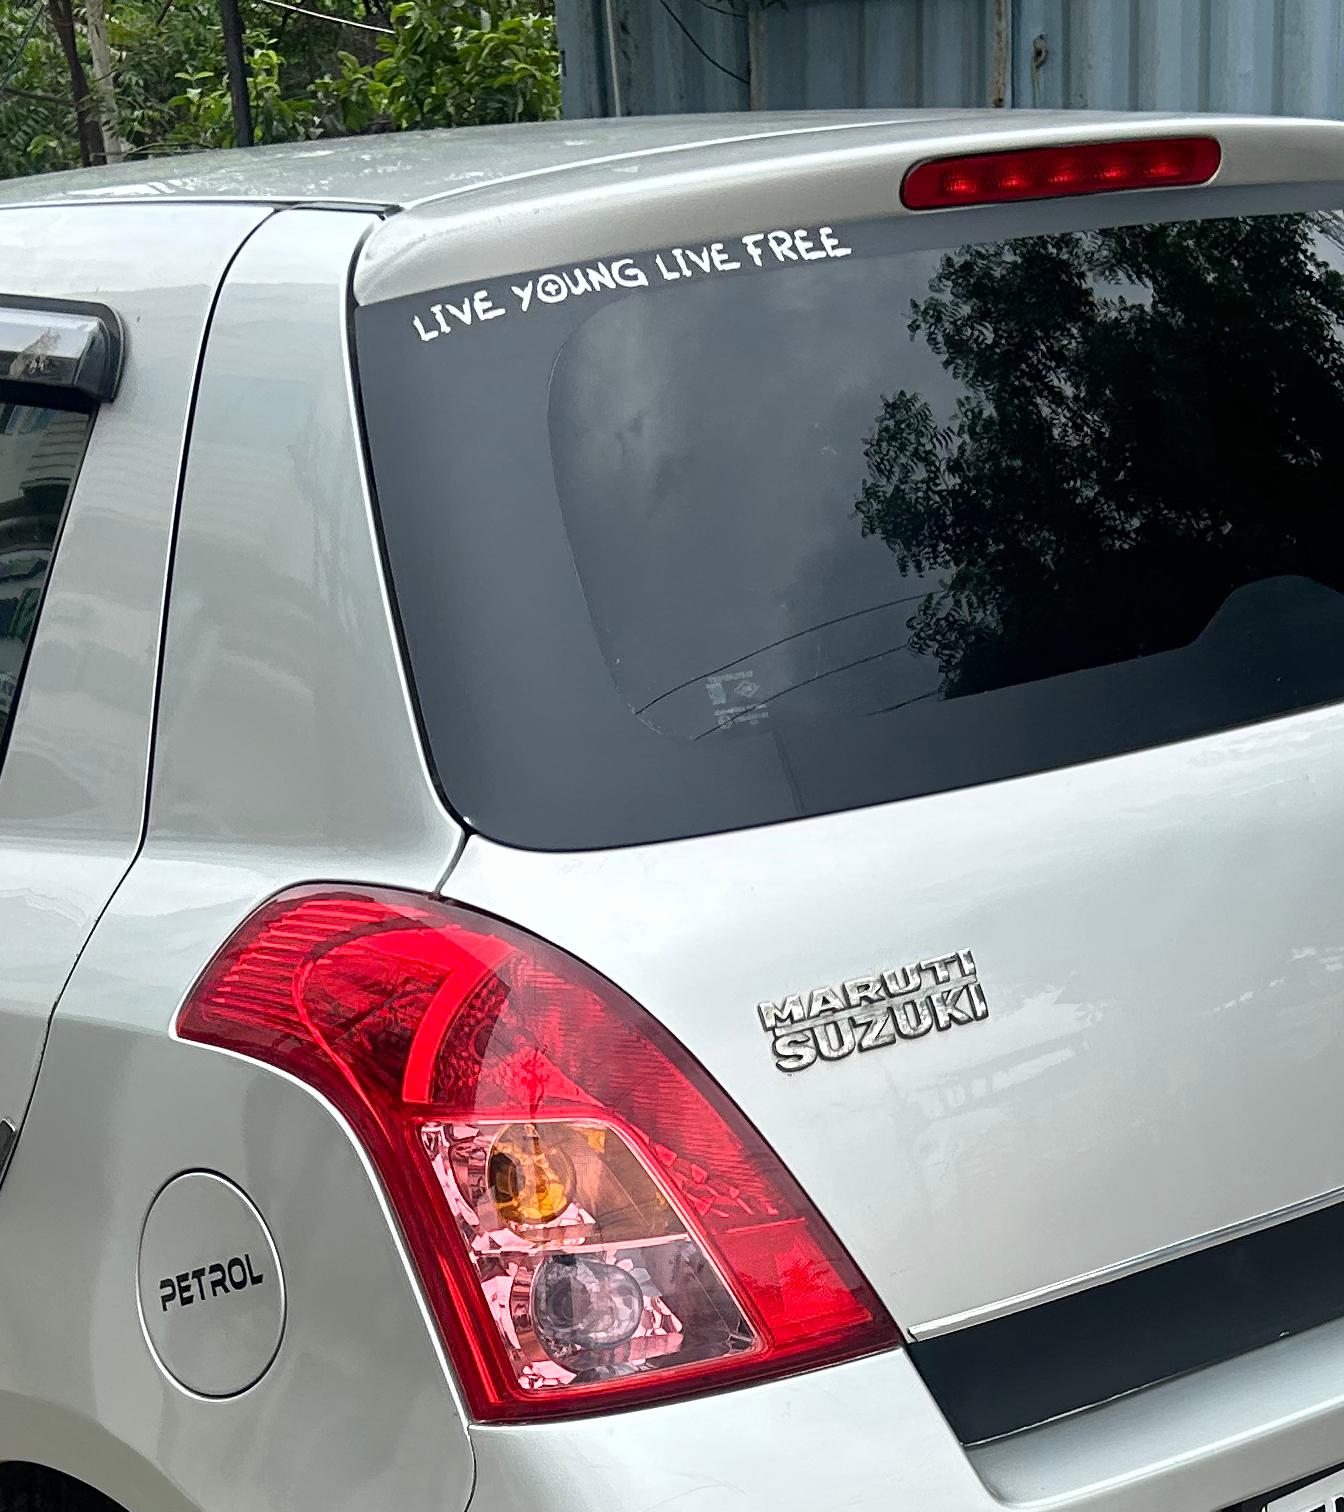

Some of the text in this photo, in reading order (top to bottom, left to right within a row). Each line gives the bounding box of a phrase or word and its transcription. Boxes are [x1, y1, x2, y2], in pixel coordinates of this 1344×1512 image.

[413, 226, 853, 342] LIVE YOUNG LIVE FREE
[756, 947, 978, 1032] MARUTI
[771, 981, 989, 1073] SUZUKI
[159, 1253, 264, 1312] PETROL
